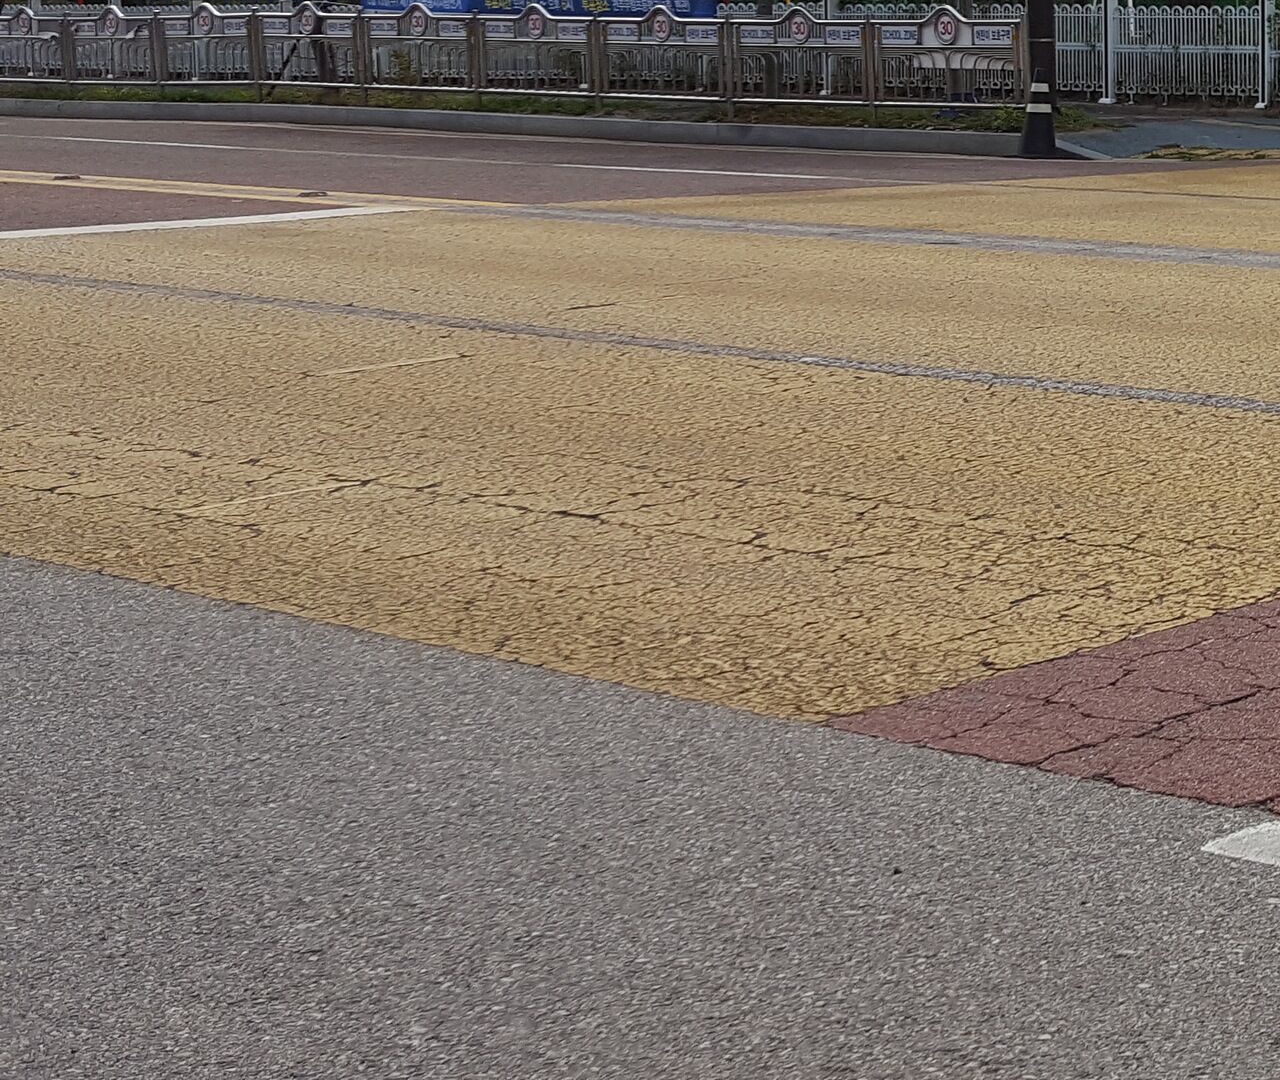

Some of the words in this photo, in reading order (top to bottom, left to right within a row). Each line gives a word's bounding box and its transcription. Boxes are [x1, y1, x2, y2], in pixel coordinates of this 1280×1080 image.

[530, 17, 541, 31] 30
[655, 20, 667, 33] 30
[793, 21, 805, 35] 30
[939, 21, 952, 35] 30
[882, 29, 902, 40] SCHOOL
[975, 29, 991, 41] 어린이
